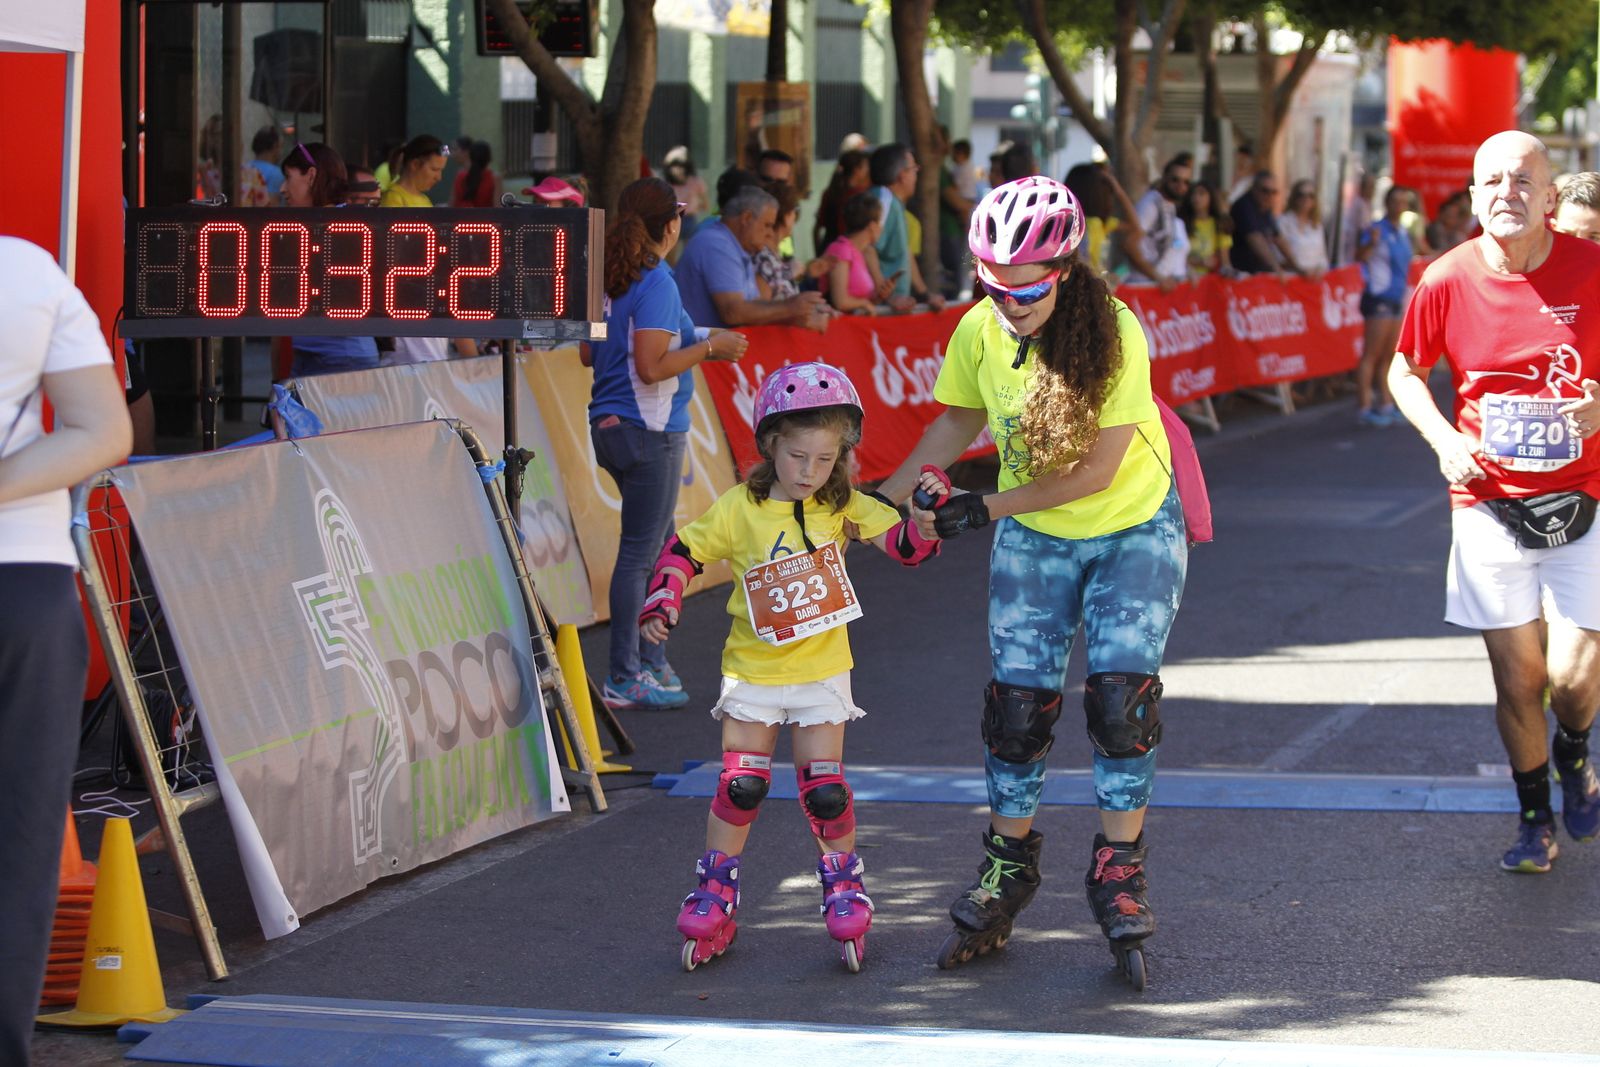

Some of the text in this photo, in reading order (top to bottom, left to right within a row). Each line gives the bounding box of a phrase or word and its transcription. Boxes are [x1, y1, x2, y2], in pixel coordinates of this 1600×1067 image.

[199, 222, 565, 320] 00:32:21
[1490, 418, 1564, 445] 2120
[1518, 445, 1546, 457] EL ZURI
[764, 566, 774, 583] 6
[776, 554, 814, 572] CARRERA
[778, 562, 816, 579] SOLIDARIA
[358, 543, 517, 657] FUNDACIÓN
[768, 574, 828, 613] 323
[795, 603, 820, 621] DARÍO
[385, 631, 534, 763] POCO
